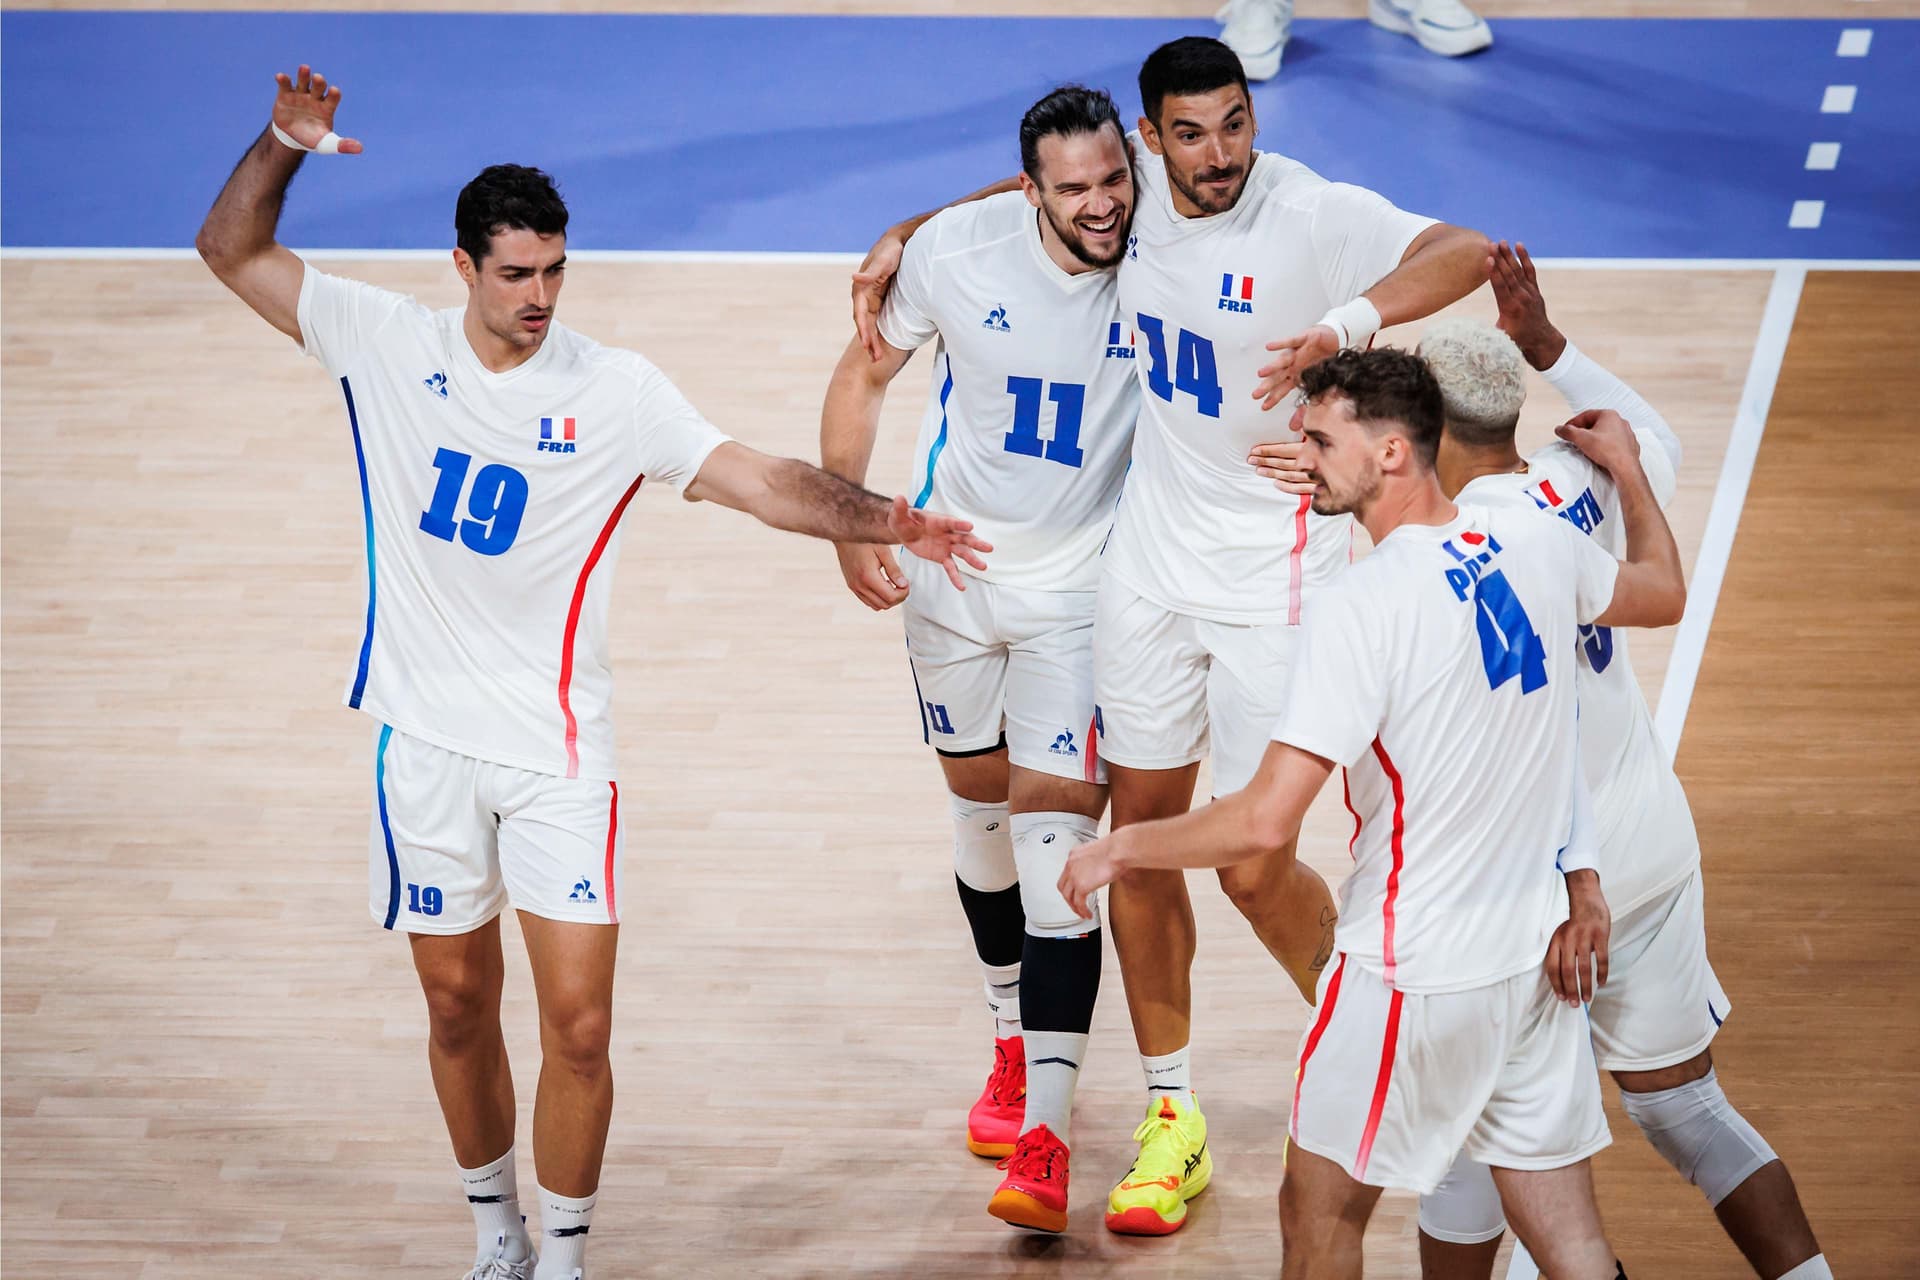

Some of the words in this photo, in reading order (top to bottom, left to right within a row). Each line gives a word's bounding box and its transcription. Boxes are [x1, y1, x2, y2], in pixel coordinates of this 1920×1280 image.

[1218, 298, 1253, 313] FRA
[1137, 312, 1223, 418] 14
[537, 441, 576, 453] FRA
[1004, 376, 1086, 468] 11
[419, 447, 529, 556] 19
[1474, 569, 1548, 695] 4
[926, 701, 955, 734] 11
[408, 883, 443, 916] 19
